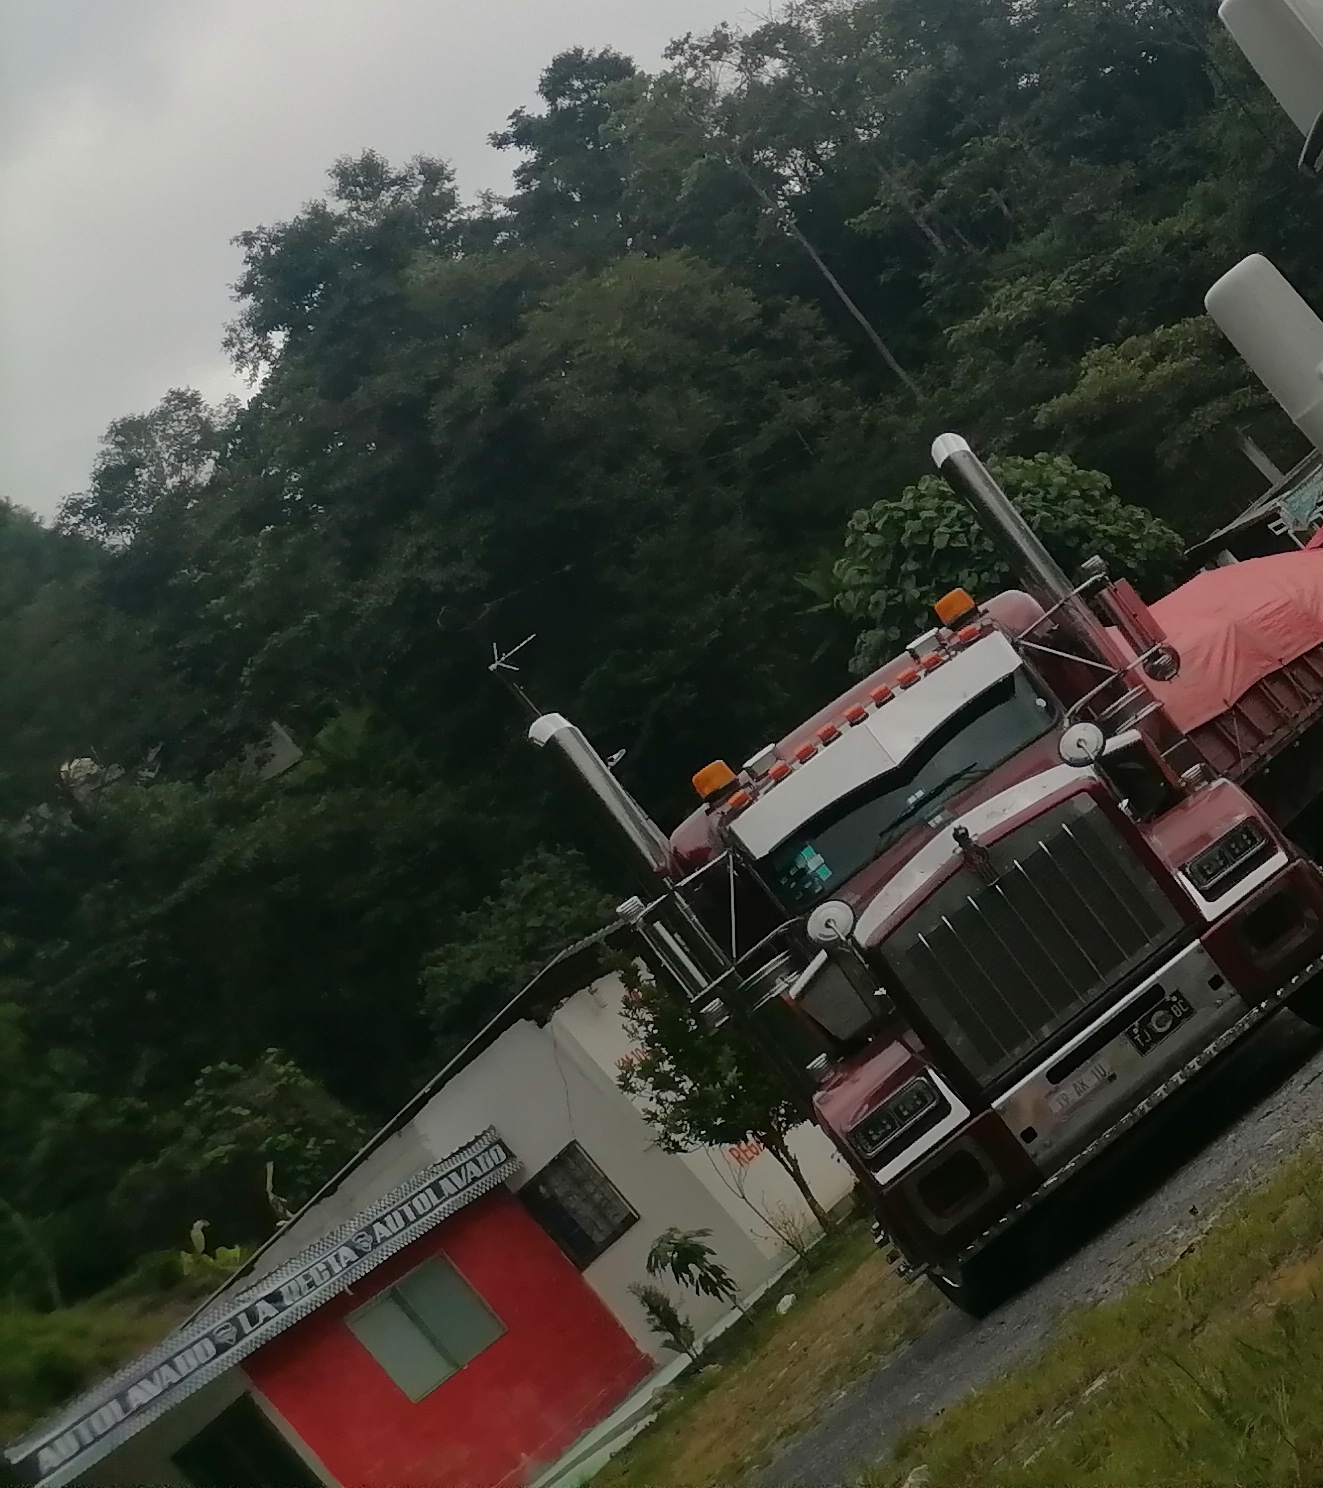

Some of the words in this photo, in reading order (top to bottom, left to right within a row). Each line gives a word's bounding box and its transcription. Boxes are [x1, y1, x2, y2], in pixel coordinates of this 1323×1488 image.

[37, 1337, 217, 1476] AUTOLAVADO
[238, 1299, 280, 1335] LA
[372, 1142, 508, 1244] AUTOLAVADO
